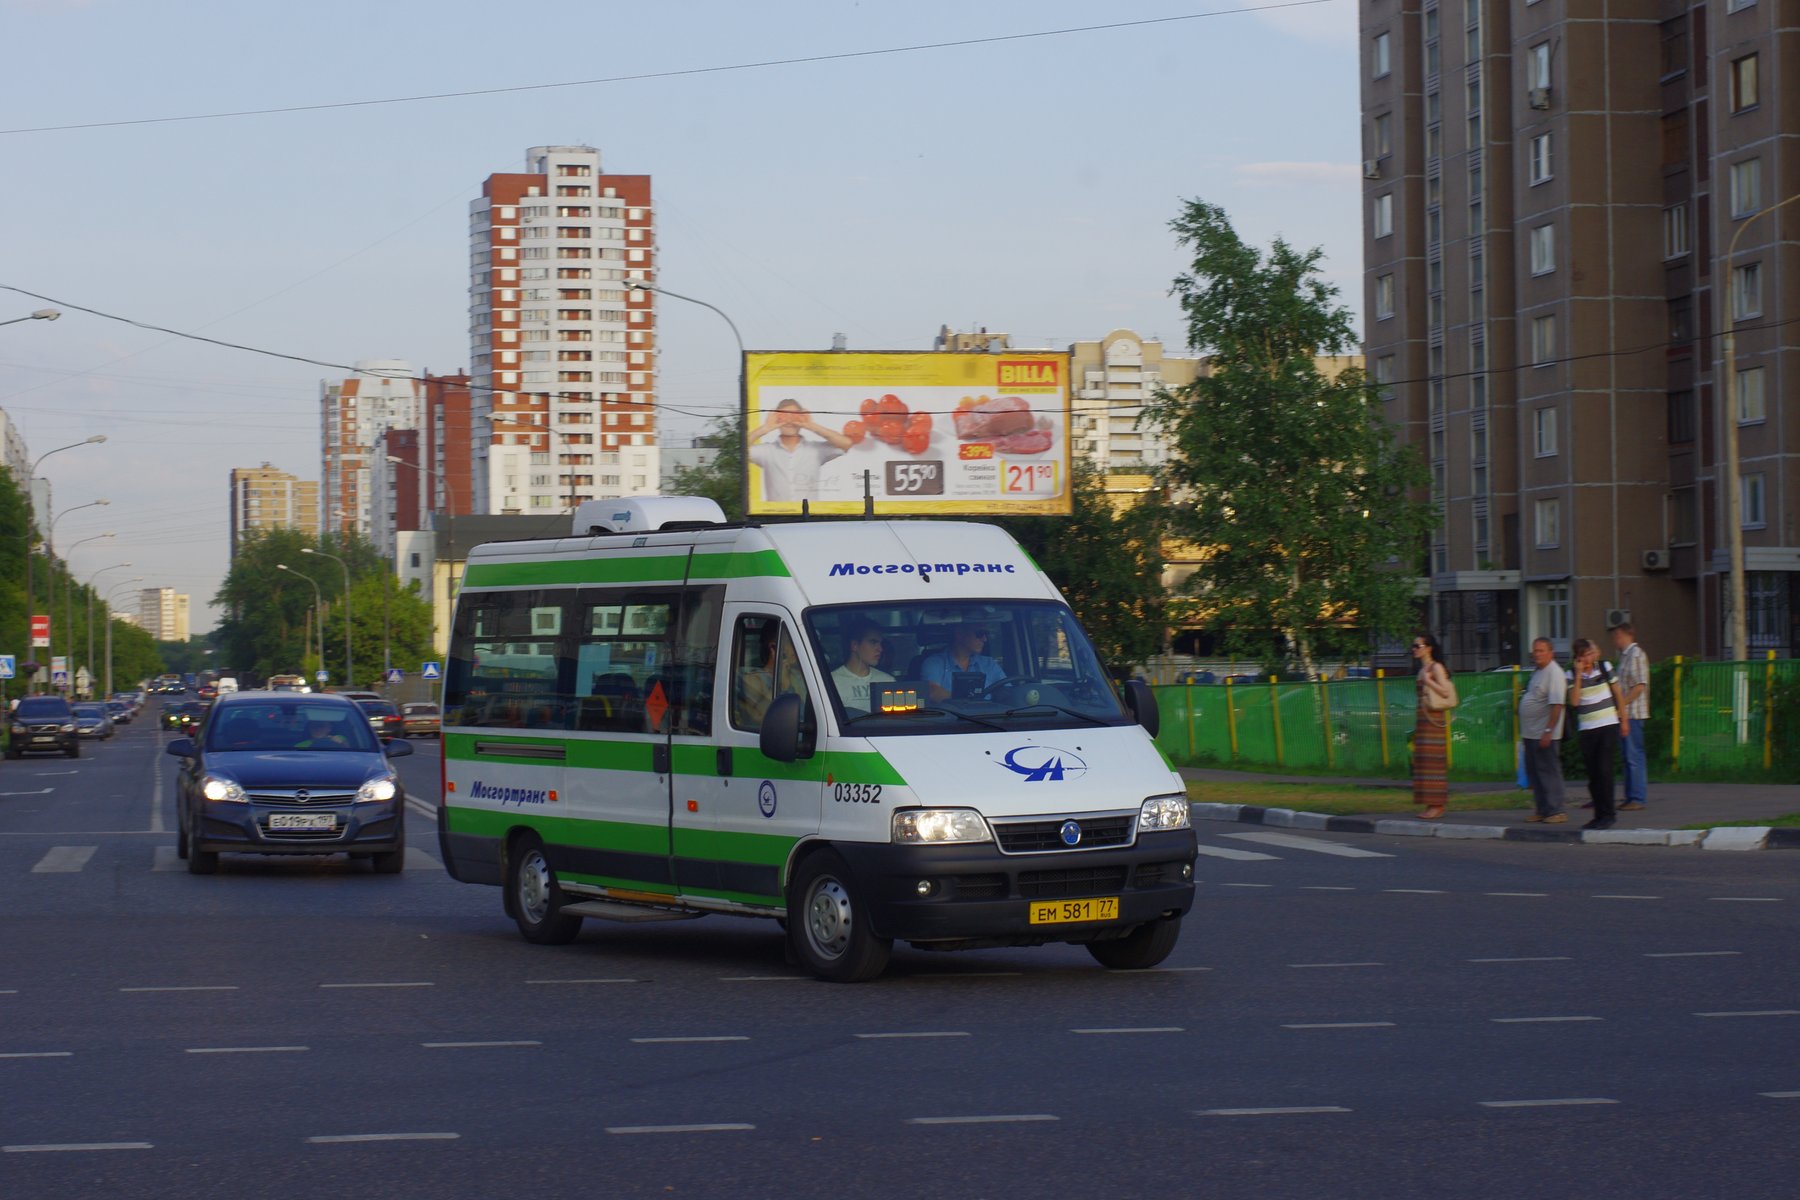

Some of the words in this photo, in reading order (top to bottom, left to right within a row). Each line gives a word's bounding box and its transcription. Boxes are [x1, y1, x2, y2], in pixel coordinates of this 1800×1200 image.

[1001, 365, 1056, 383] BILLA
[962, 445, 992, 458] -39%
[828, 563, 1015, 577] Мосгортранс
[470, 781, 547, 807] Мосгортранс
[834, 783, 882, 804] 03352
[1038, 908, 1057, 921] ЕМ
[1063, 902, 1090, 919] 581
[1099, 900, 1114, 913] 77
